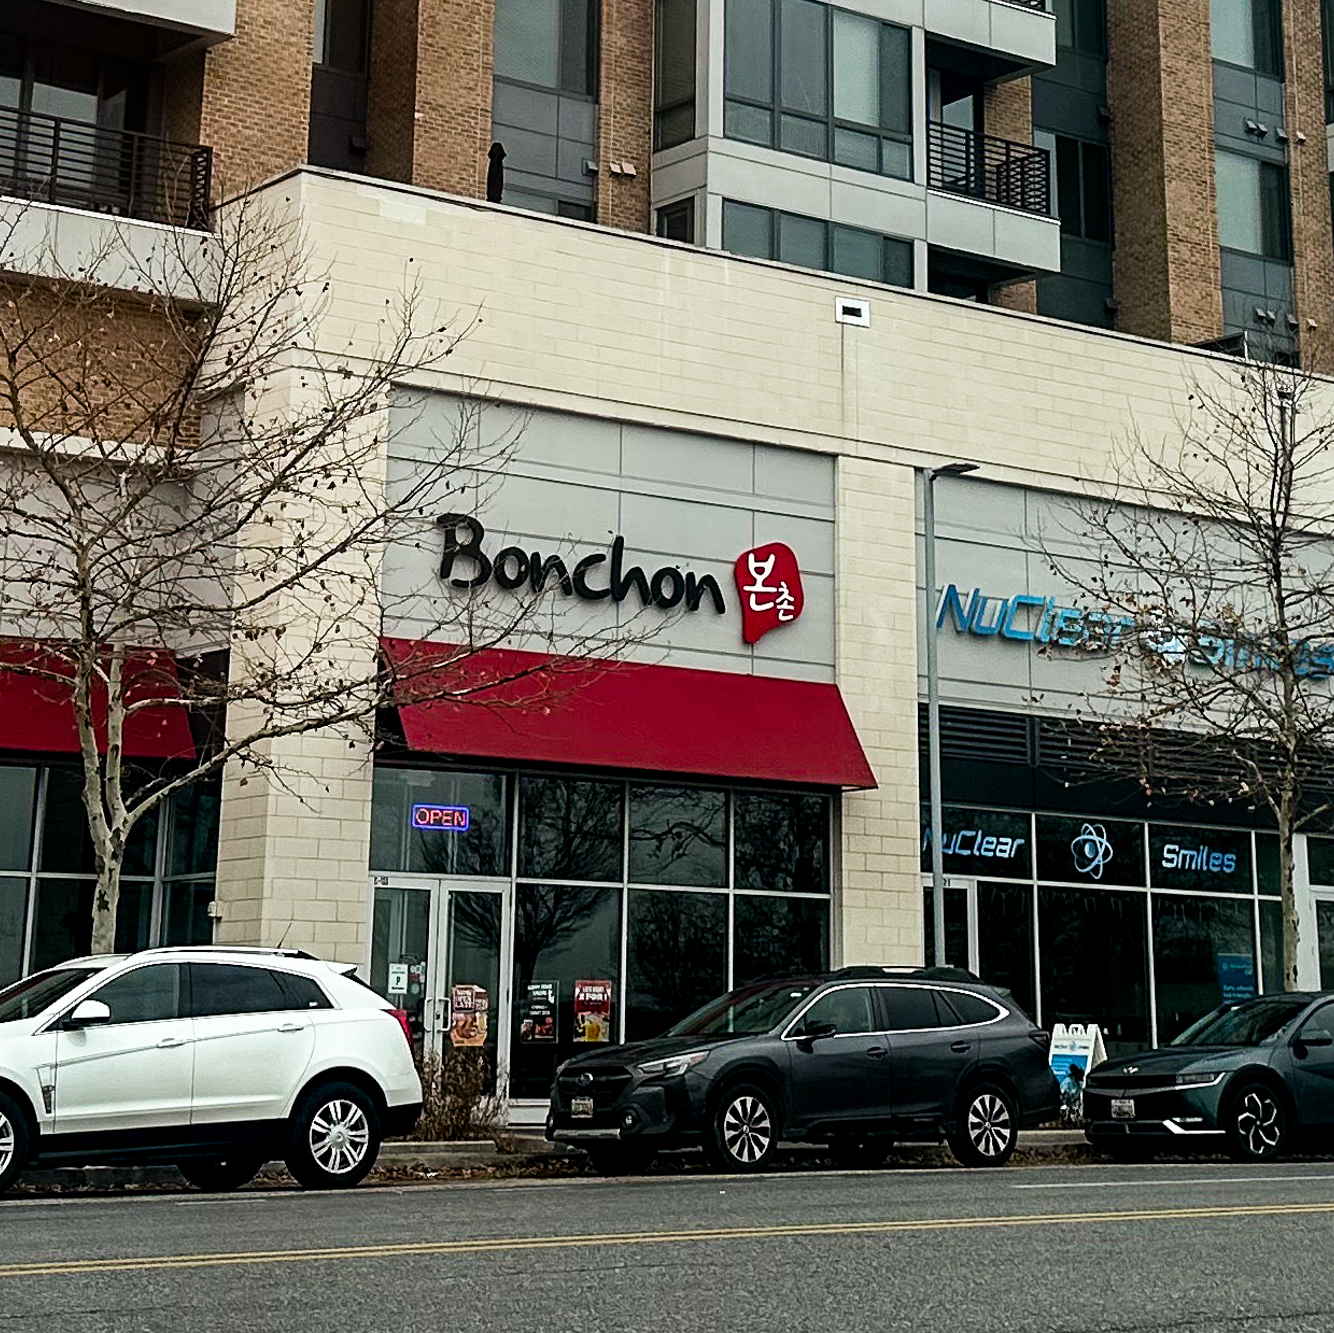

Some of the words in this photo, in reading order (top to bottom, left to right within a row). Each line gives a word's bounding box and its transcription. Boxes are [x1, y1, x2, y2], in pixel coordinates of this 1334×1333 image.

[436, 513, 726, 615] Bonchon
[743, 553, 795, 621] 본촌
[936, 584, 1135, 652] NuClear
[416, 808, 466, 826] OPEN
[1162, 844, 1236, 873] Smiles
